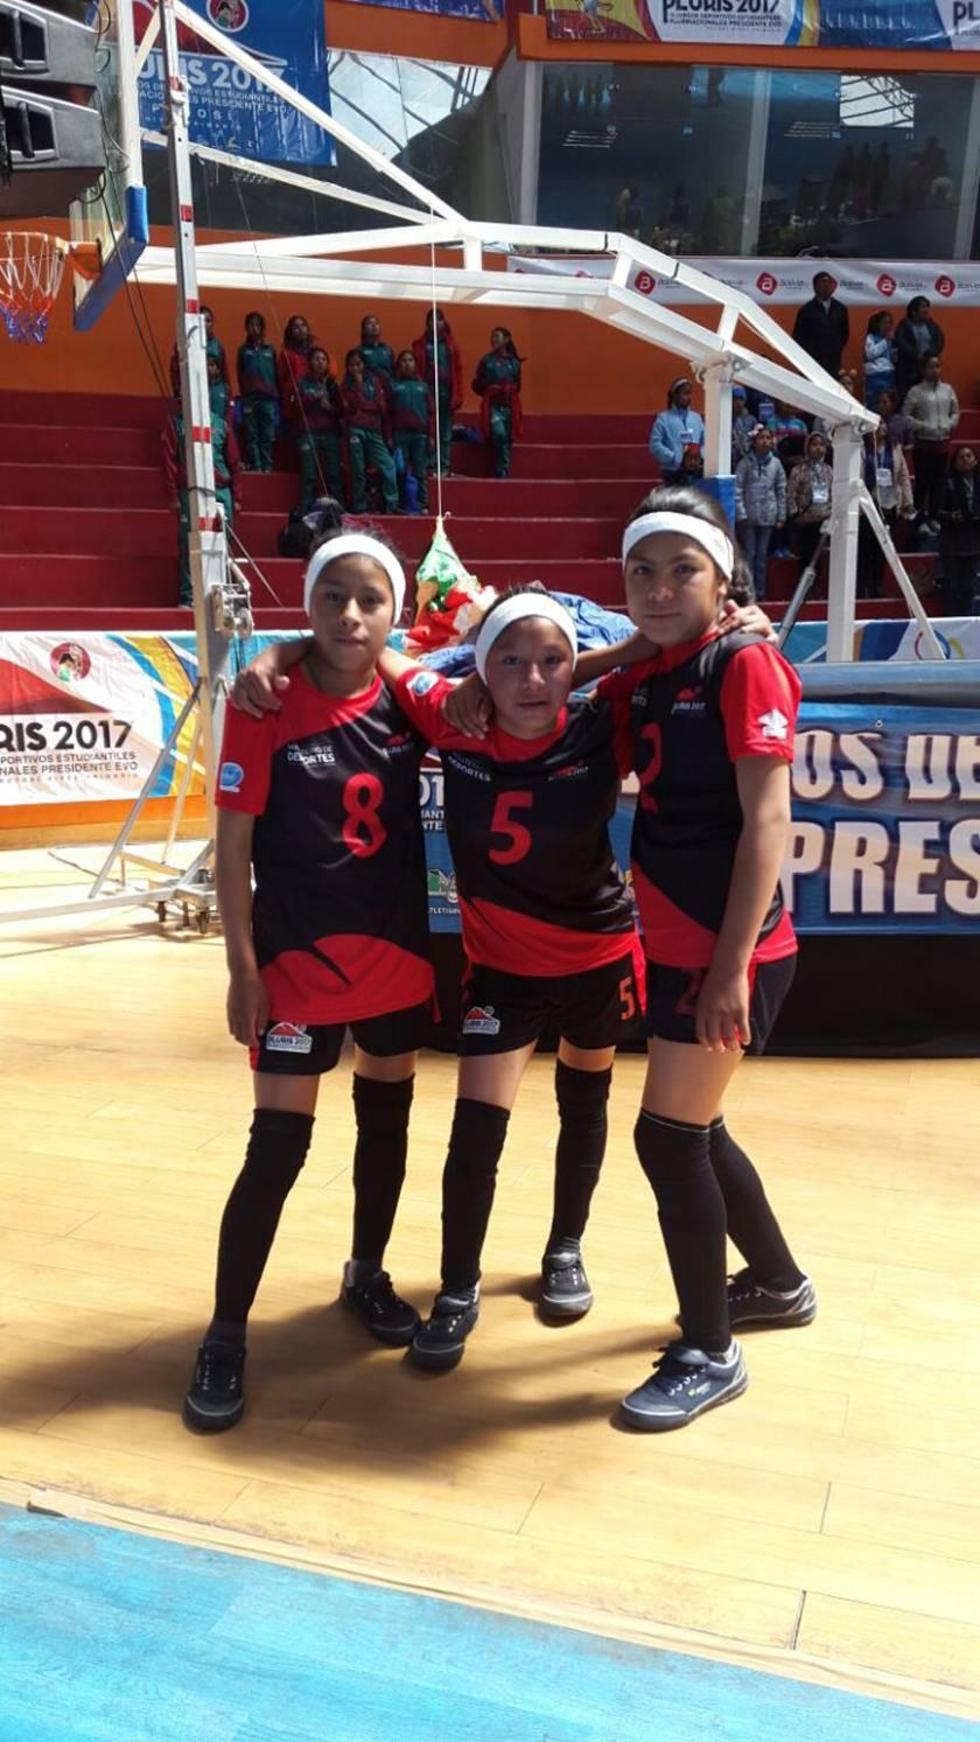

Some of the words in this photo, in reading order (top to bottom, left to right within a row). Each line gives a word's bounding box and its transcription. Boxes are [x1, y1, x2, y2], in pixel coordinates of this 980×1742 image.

[736, 0, 780, 13] 2017
[53, 720, 132, 750] 2017
[41, 762, 112, 774] PRESIDENTE
[115, 761, 138, 771] EVO
[56, 751, 137, 763] ESTUDIANTILES
[342, 772, 388, 858] 8
[488, 790, 535, 866] 5
[780, 818, 980, 915] PRES
[619, 976, 636, 1020] 5
